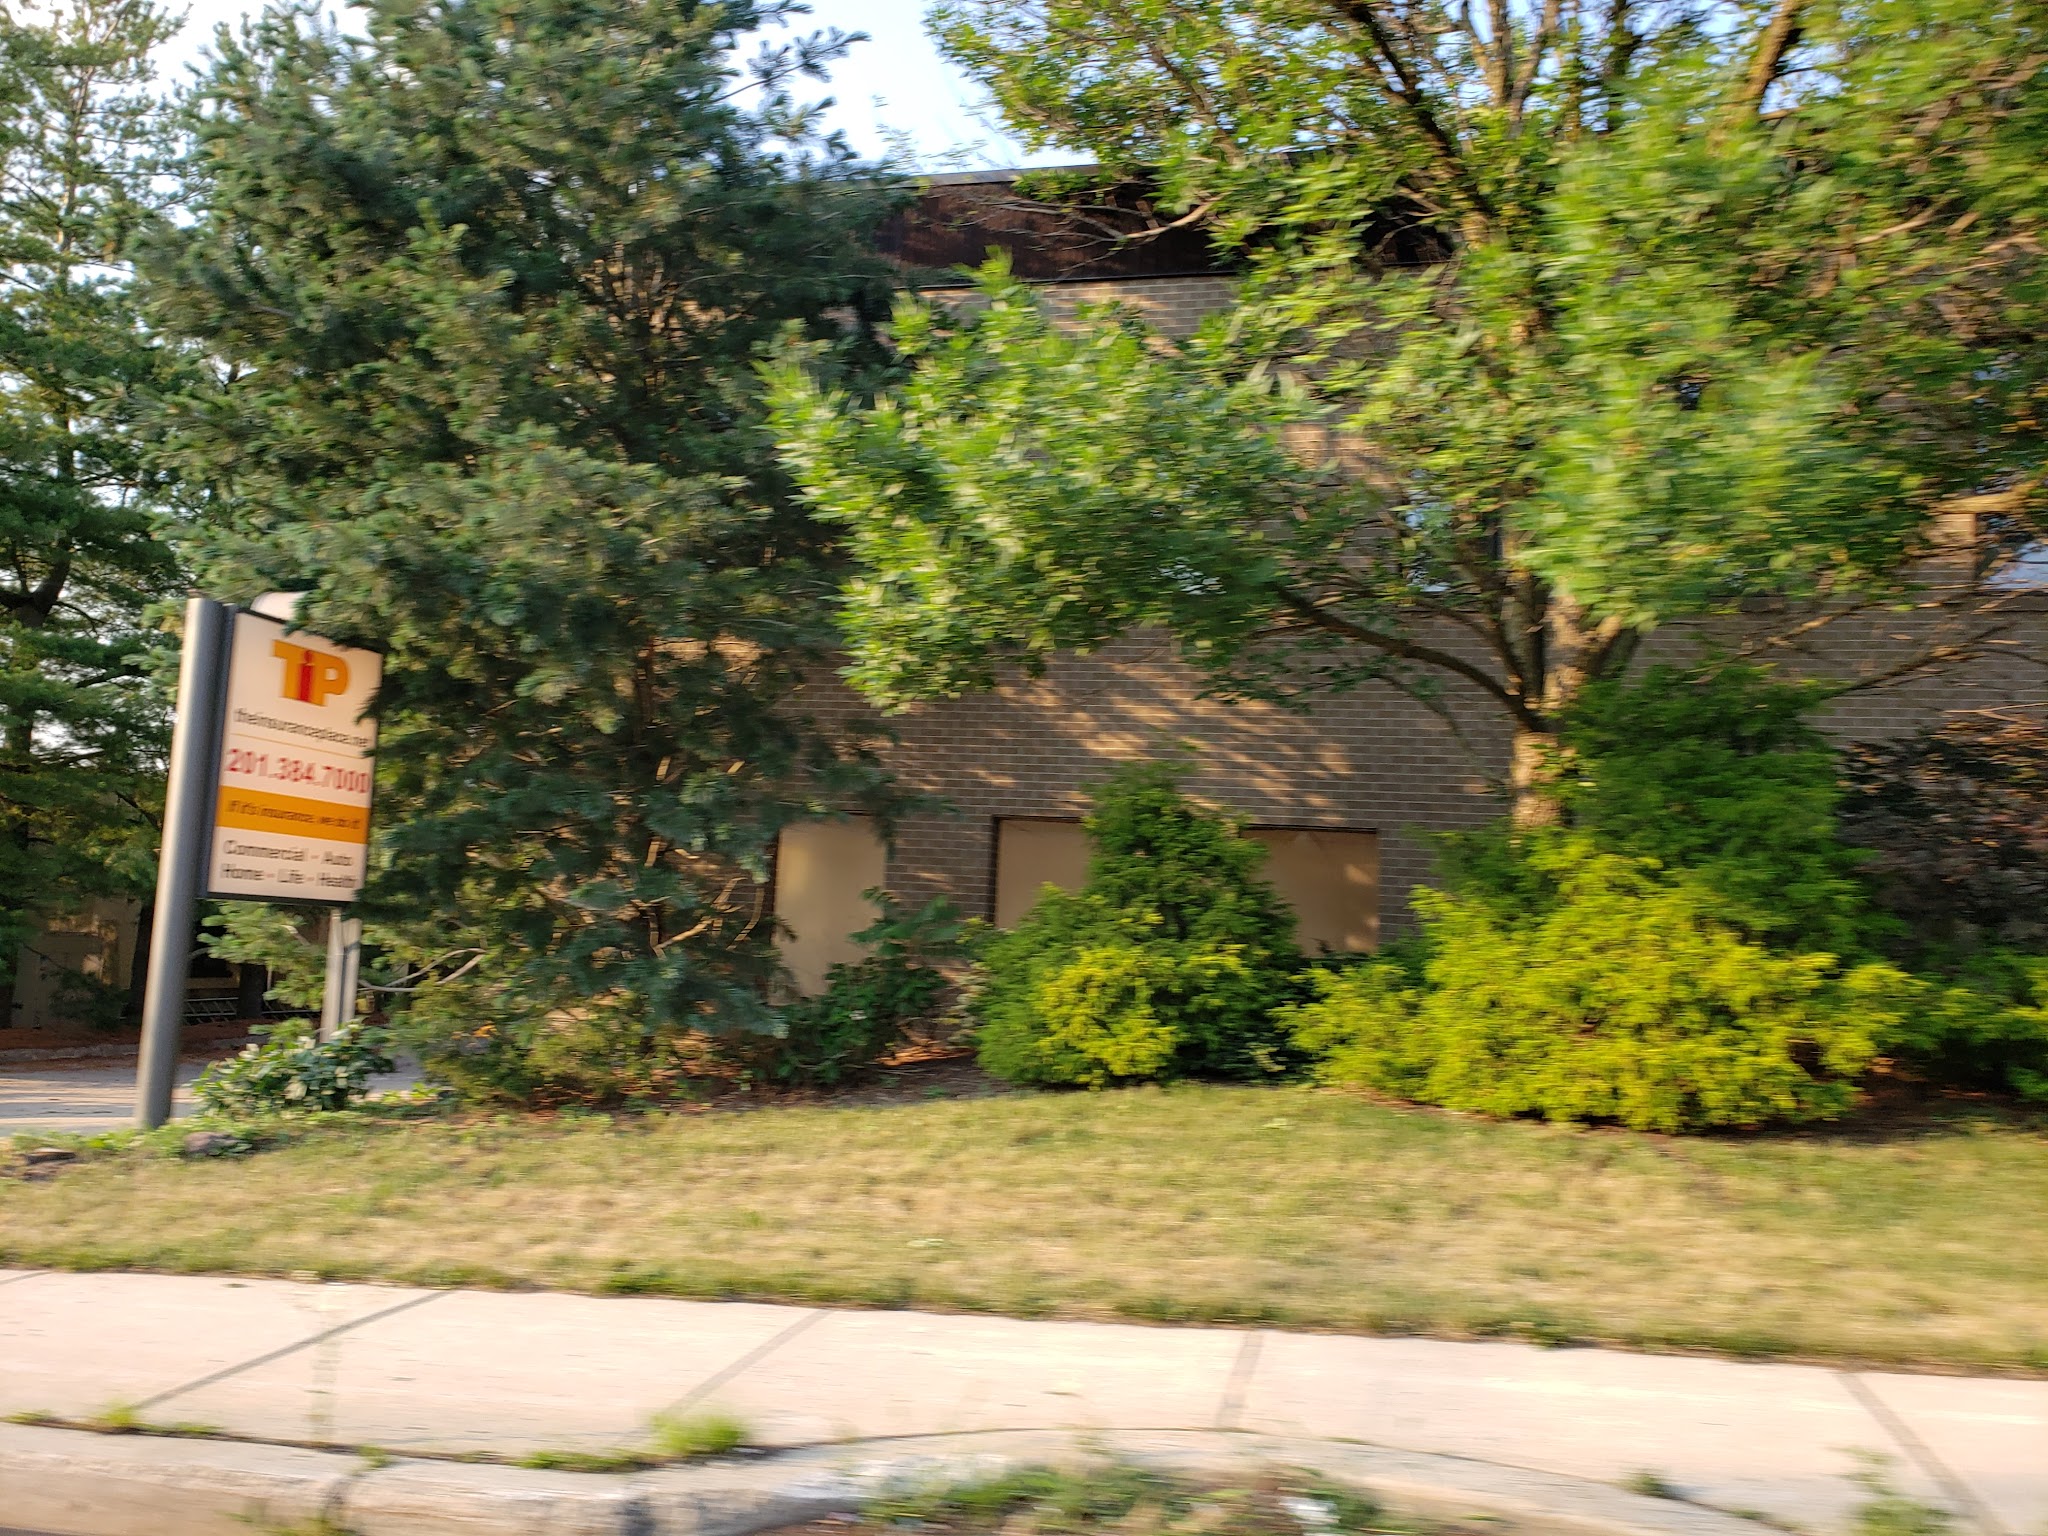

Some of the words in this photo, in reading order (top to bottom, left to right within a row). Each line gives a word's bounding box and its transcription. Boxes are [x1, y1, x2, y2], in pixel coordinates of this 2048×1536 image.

[272, 638, 350, 707] TiP
[225, 748, 370, 793] 201.384.7000
[223, 839, 309, 863] Commercial
[321, 850, 353, 867] Auto
[220, 863, 265, 881] Home
[277, 868, 305, 885] Life
[315, 872, 357, 889] Health
